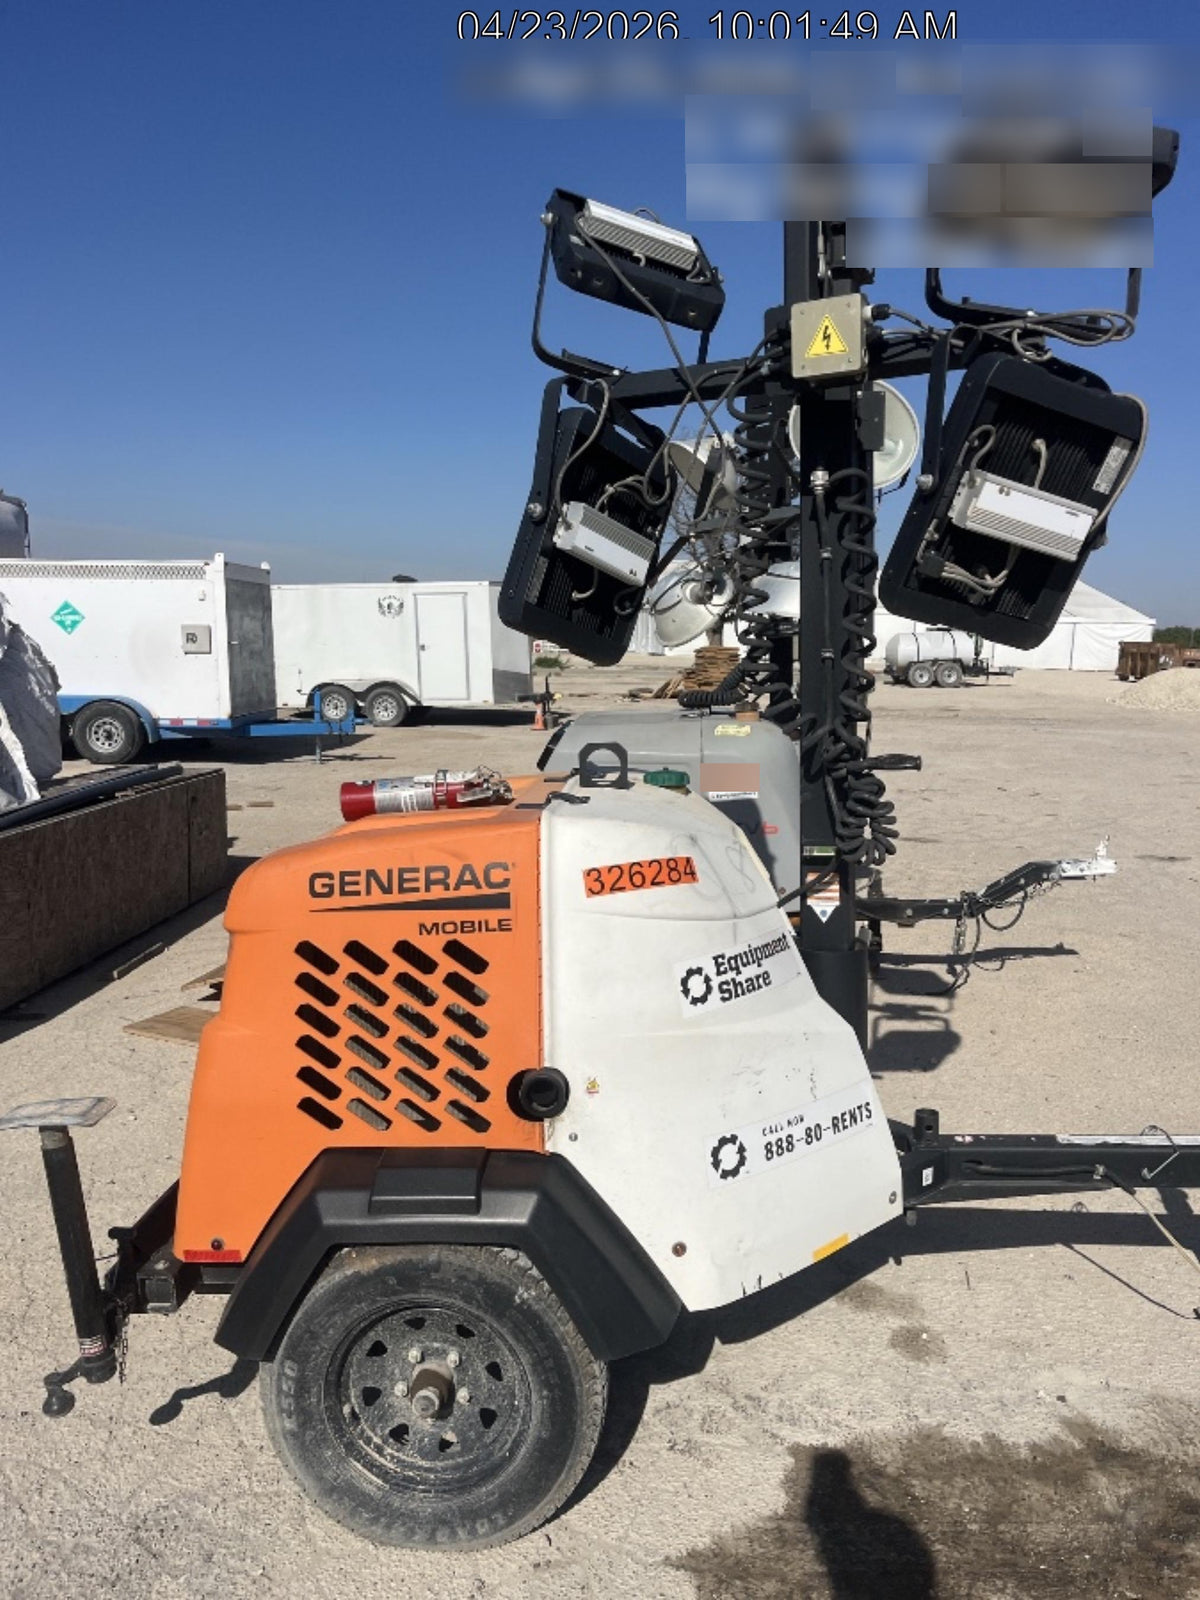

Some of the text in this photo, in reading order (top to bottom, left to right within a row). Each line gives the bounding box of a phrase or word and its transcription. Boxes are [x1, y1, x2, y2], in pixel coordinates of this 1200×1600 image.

[309, 862, 511, 898] GENERAC
[586, 857, 696, 895] 326284
[419, 918, 512, 936] MOBILE
[712, 932, 791, 976] Equipment
[718, 971, 772, 1003] Share
[762, 1113, 805, 1137] CALL NOW
[764, 1101, 872, 1161] 888-80-RENTS
